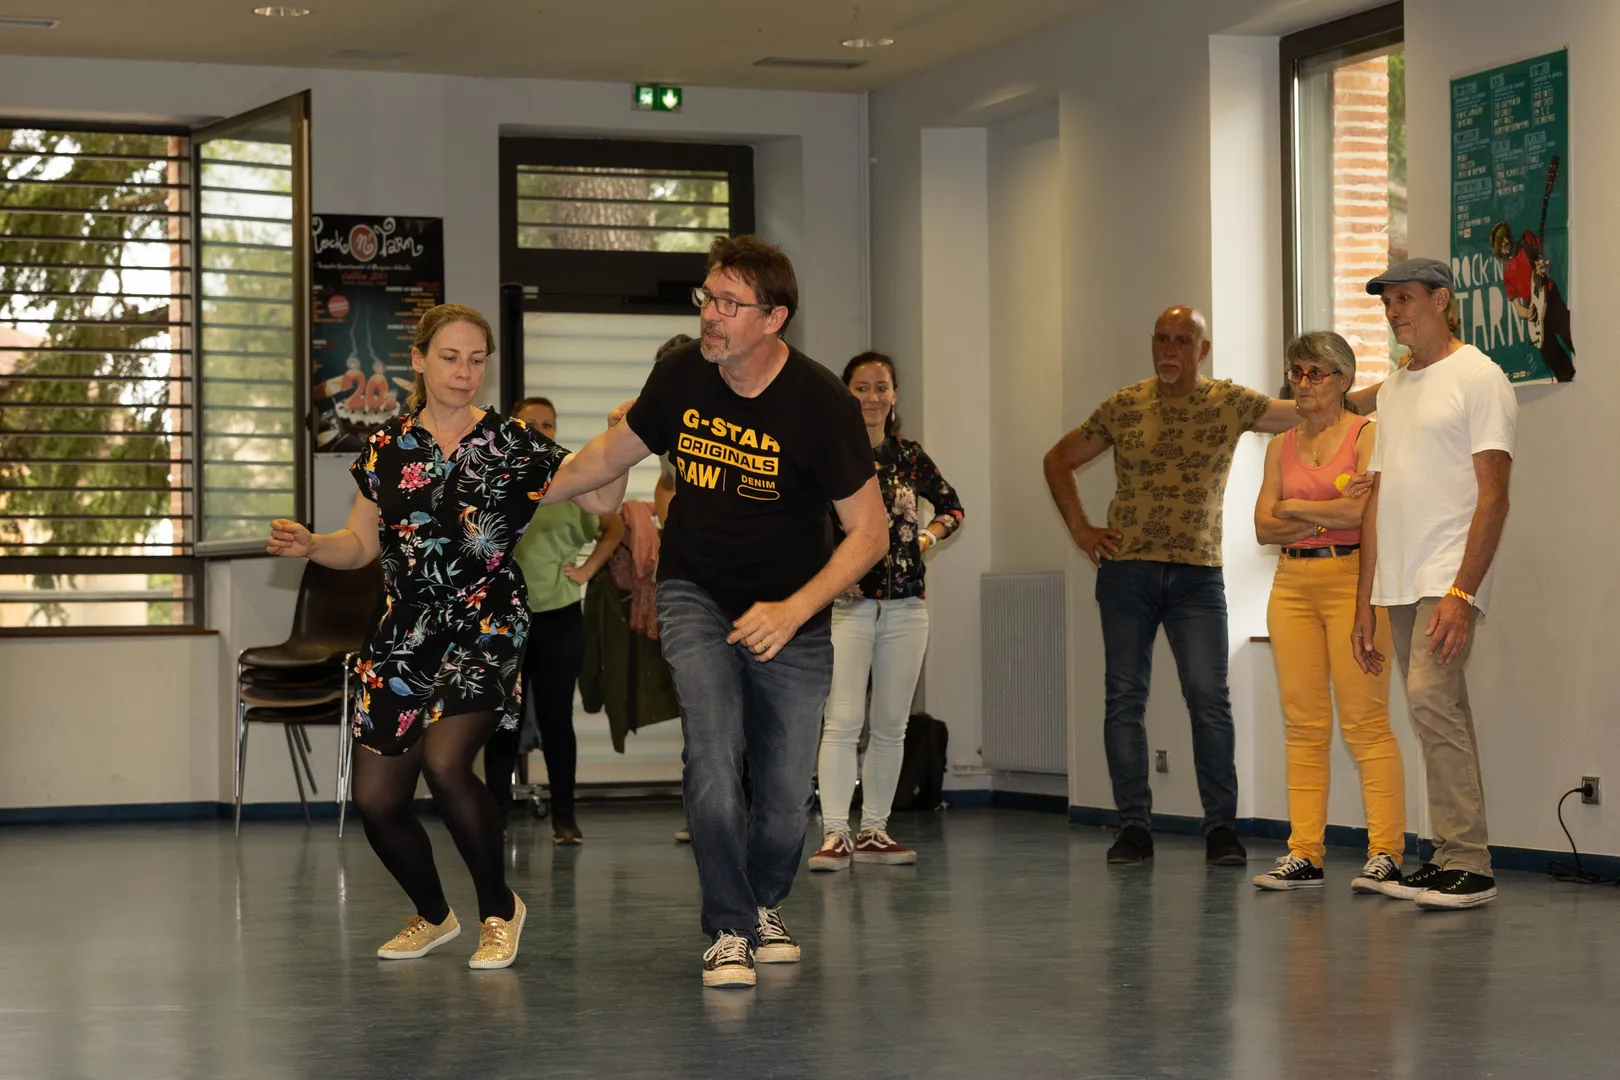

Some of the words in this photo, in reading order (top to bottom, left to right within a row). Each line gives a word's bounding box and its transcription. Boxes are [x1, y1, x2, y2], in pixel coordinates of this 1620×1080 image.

[1454, 286, 1524, 351] TARN
[683, 408, 780, 453] G-STAR
[676, 456, 722, 490] RAW
[741, 474, 776, 490] DENIM
[679, 435, 777, 474] ORIGINALS
